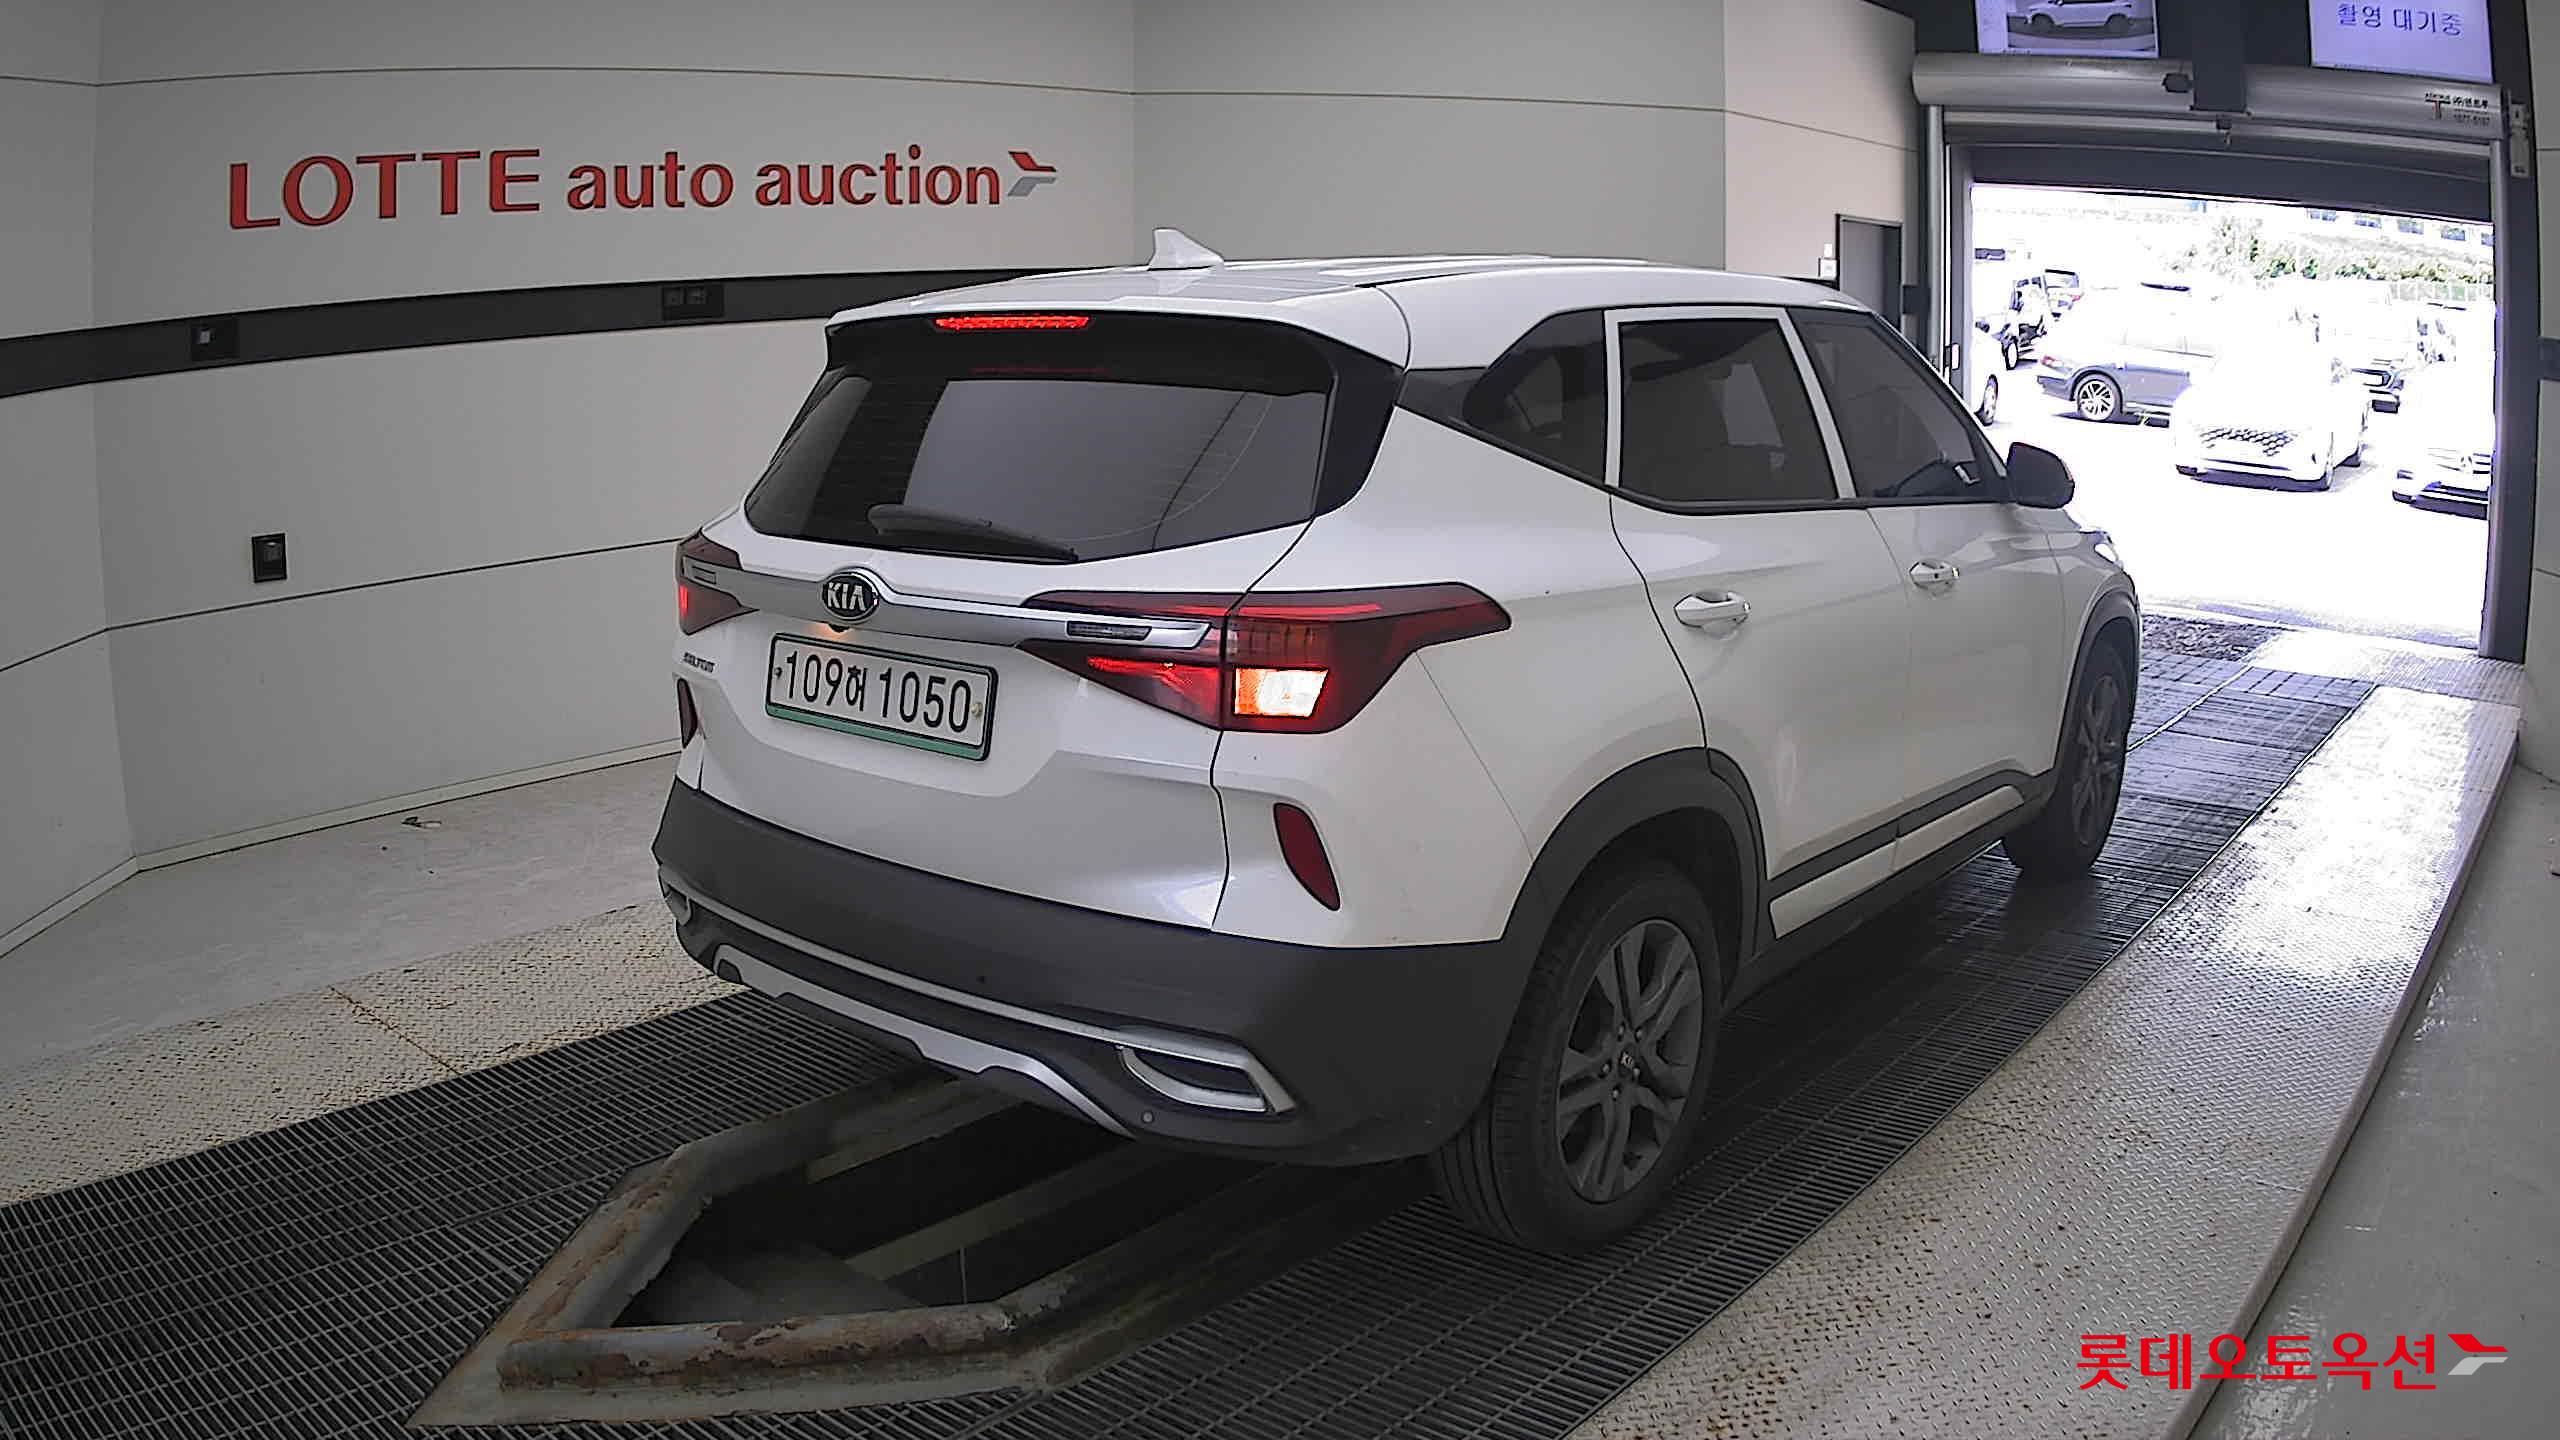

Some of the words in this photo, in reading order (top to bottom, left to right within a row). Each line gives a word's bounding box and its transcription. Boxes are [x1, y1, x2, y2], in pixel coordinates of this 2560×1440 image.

[2393, 8, 2461, 36] 대기중
[229, 149, 540, 230] LOTTE
[567, 151, 733, 209] auto
[756, 144, 1000, 206] auction
[826, 581, 868, 612] KIA
[785, 650, 868, 712] 109허
[879, 666, 972, 734] 1050
